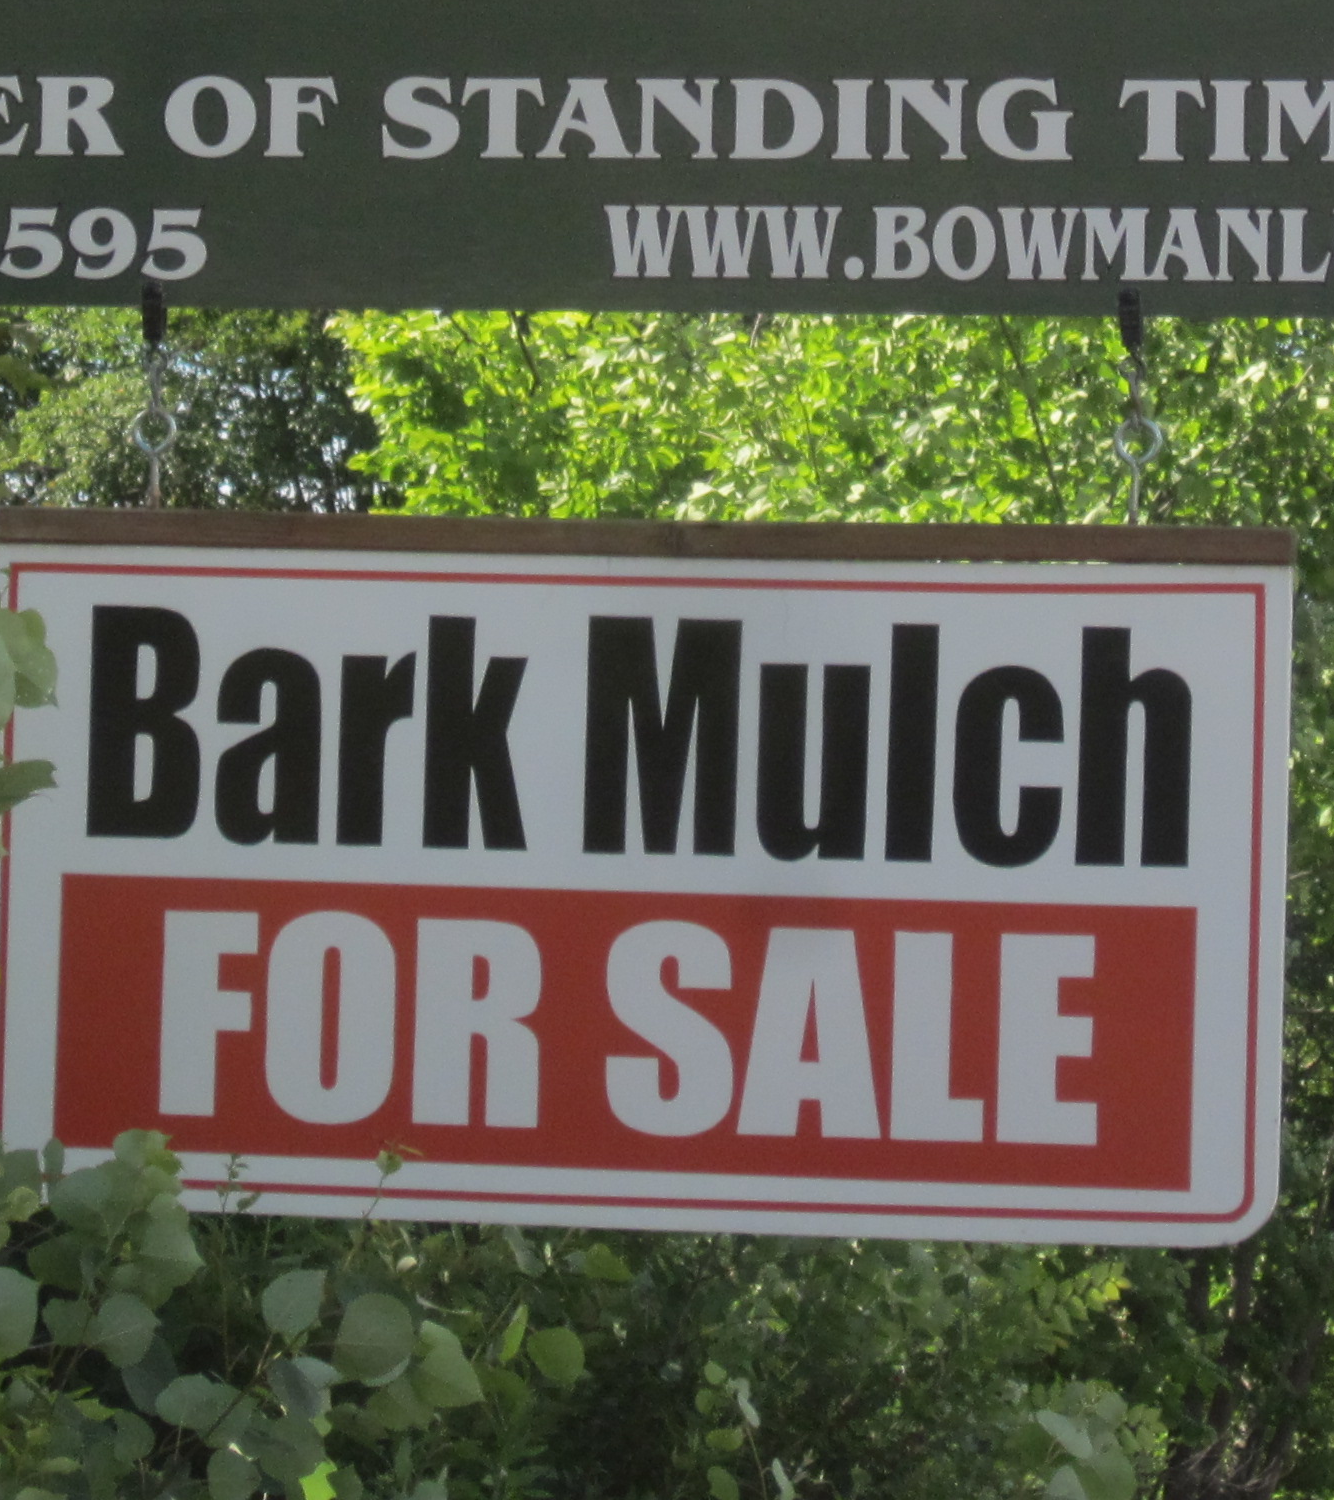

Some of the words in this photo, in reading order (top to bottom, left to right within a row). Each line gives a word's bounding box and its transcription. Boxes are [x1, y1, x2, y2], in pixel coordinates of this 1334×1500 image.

[164, 76, 336, 160] OF
[381, 74, 1074, 163] STANDING
[86, 604, 528, 852] Bark
[583, 615, 1193, 869] Mulch
[159, 908, 542, 1129] FOR
[605, 919, 1098, 1147] SALE
